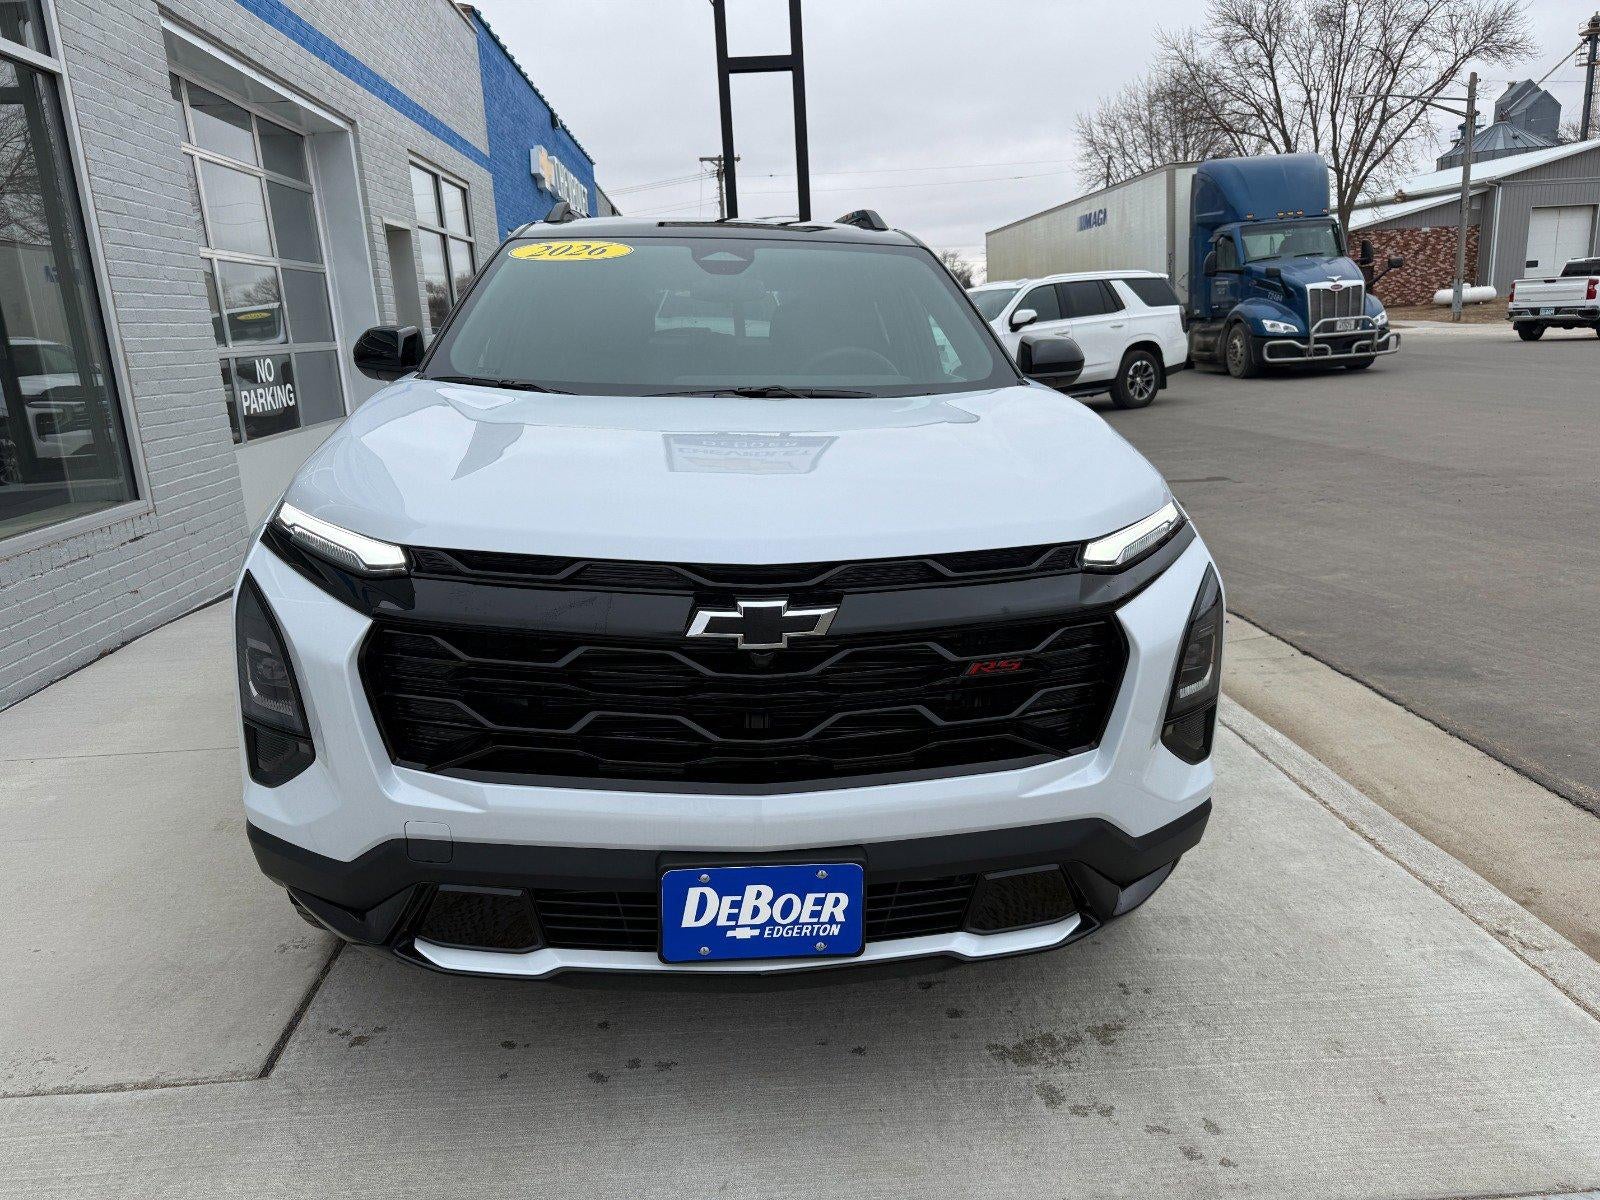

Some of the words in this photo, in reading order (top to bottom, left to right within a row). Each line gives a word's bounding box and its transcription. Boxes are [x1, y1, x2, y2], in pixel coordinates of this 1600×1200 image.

[526, 244, 613, 257] 2026
[255, 358, 275, 383] NO
[241, 383, 296, 416] PARKING
[964, 659, 1022, 676] RS
[763, 924, 841, 938] EDGERTON
